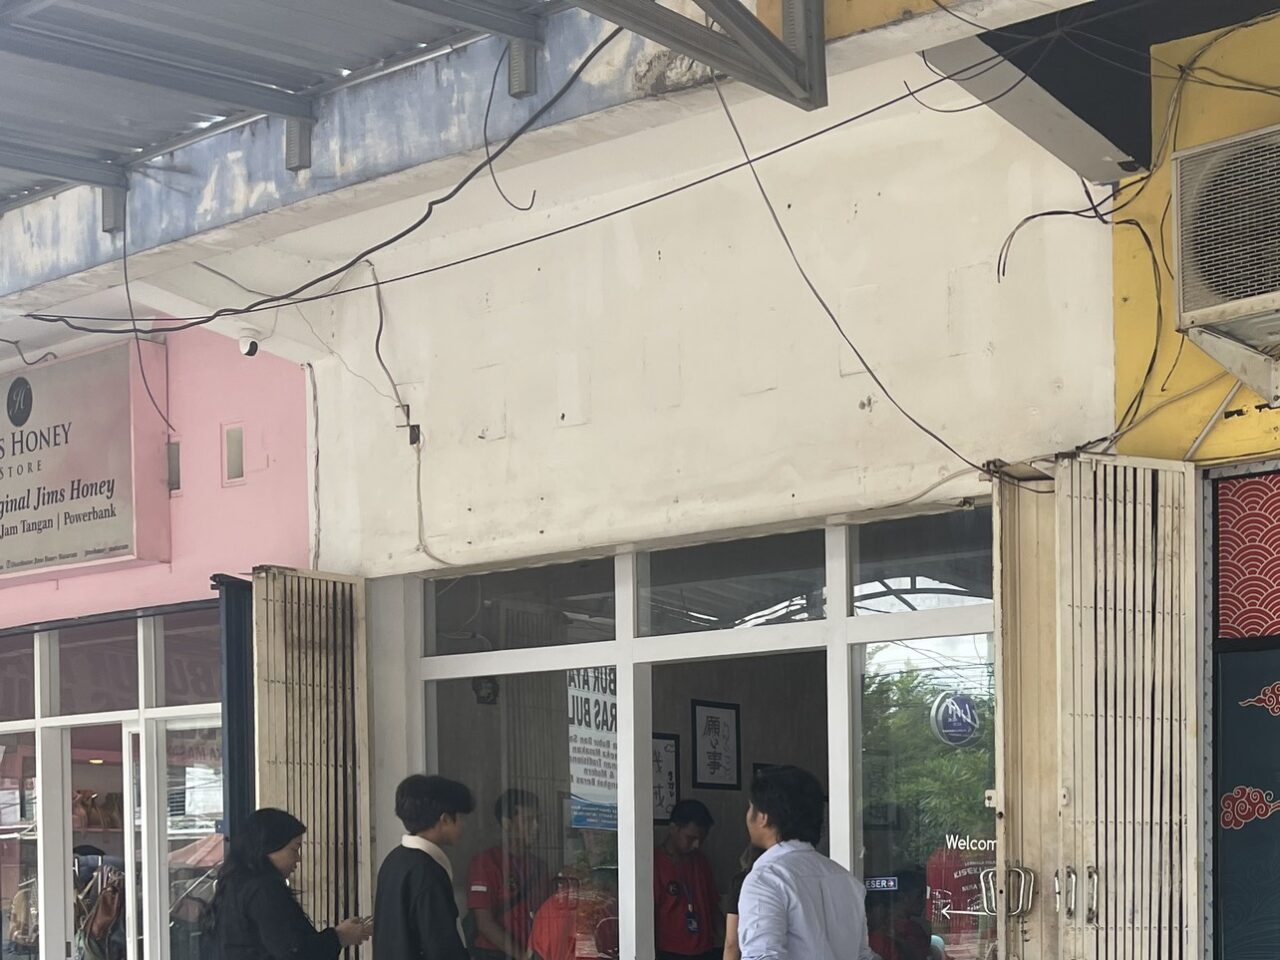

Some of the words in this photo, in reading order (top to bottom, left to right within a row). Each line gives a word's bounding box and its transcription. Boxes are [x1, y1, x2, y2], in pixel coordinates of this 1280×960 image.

[11, 421, 72, 456] HONEY
[0, 460, 42, 480] STORE
[33, 486, 66, 511] Jims
[70, 478, 115, 500] Honey
[0, 523, 18, 539] Jam
[20, 518, 53, 534] Tangan
[64, 503, 116, 525] Powerbank
